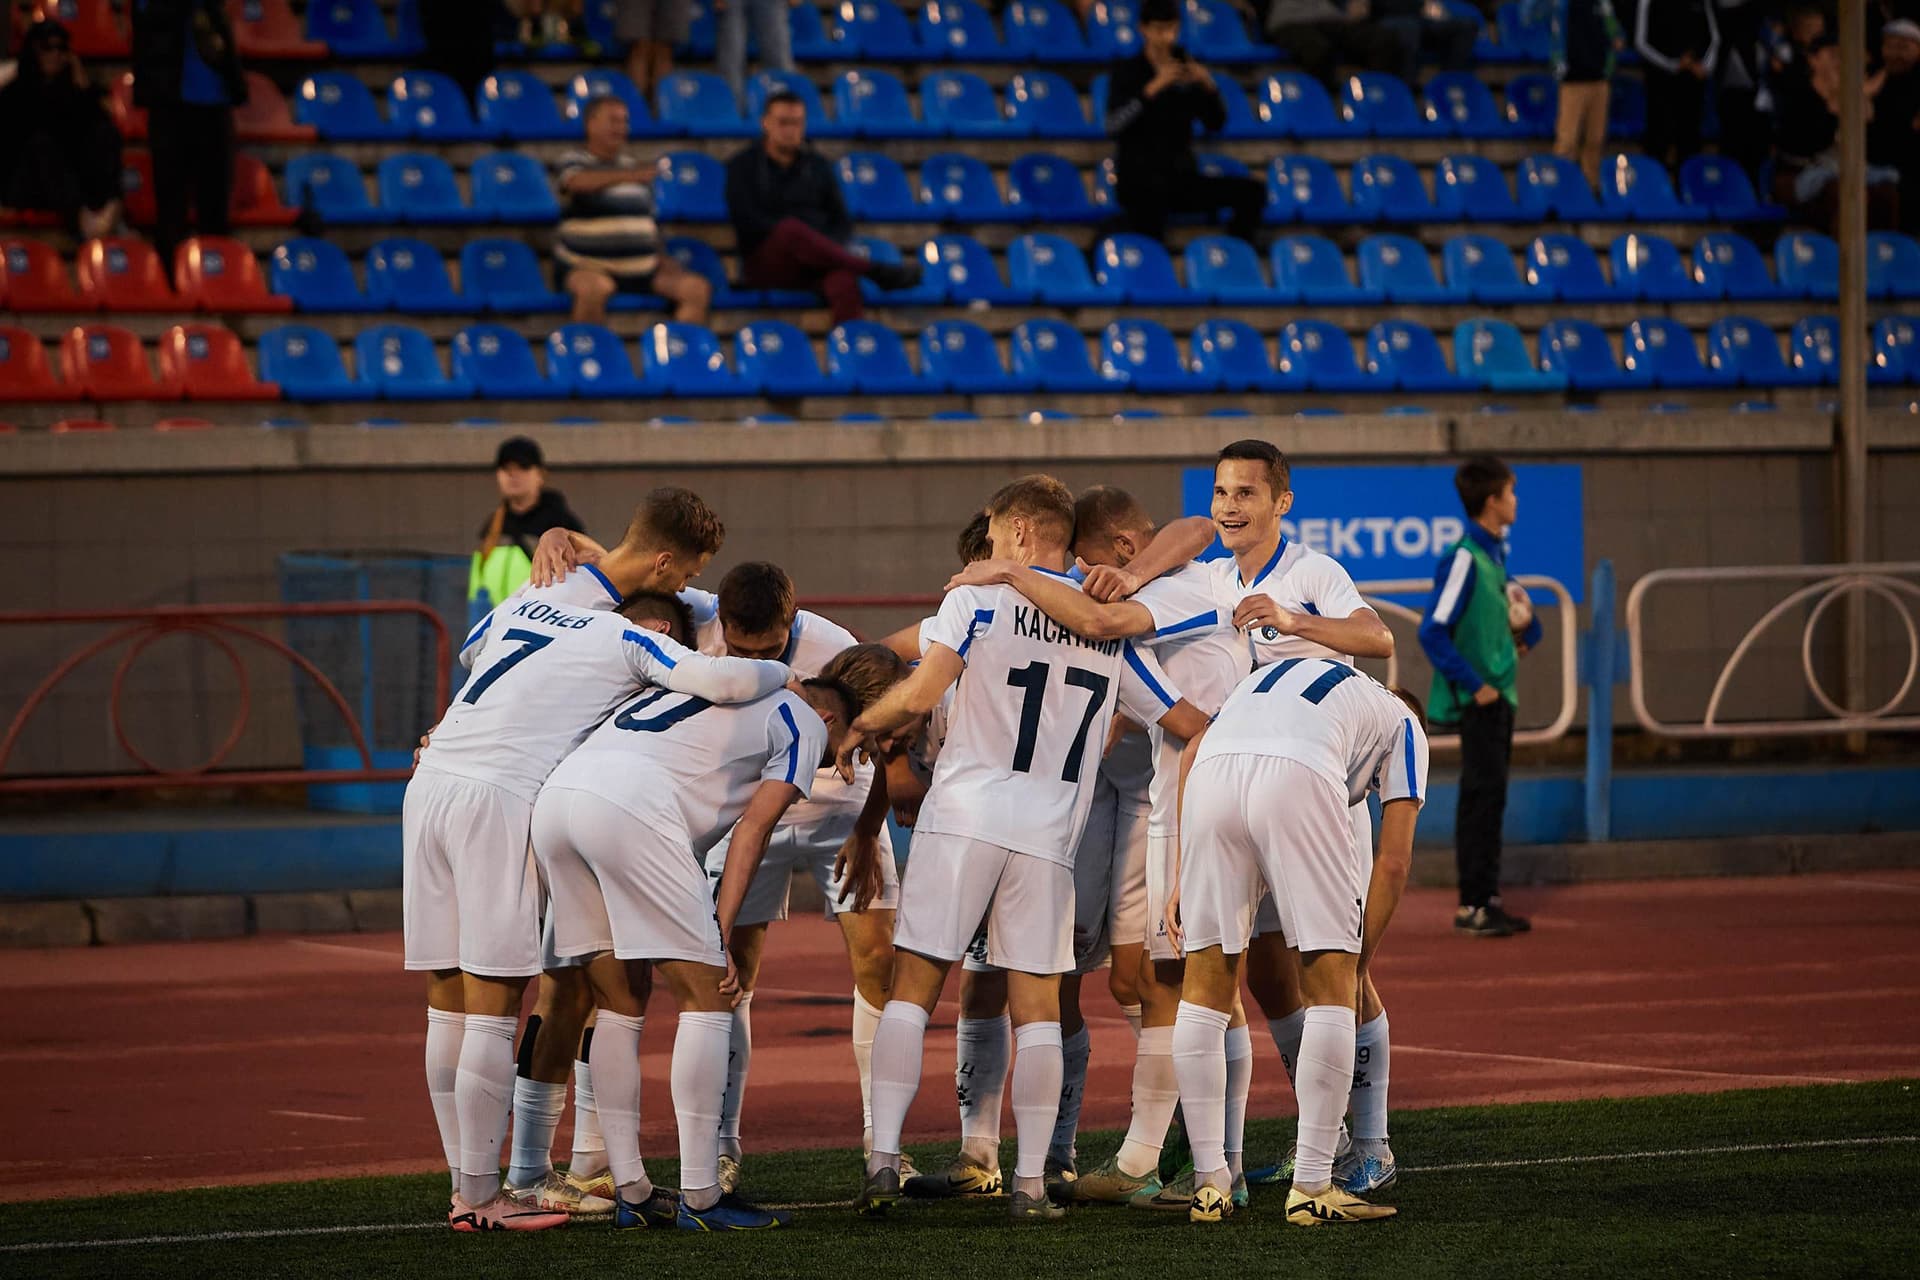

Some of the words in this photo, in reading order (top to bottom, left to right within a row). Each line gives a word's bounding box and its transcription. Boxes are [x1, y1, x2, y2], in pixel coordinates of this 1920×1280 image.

[512, 600, 595, 629] КОНЕВ
[462, 627, 555, 706] 7
[1006, 660, 1110, 784] 17
[1357, 1046, 1370, 1065] 9
[959, 1062, 976, 1079] 4
[1061, 1083, 1074, 1102] 4
